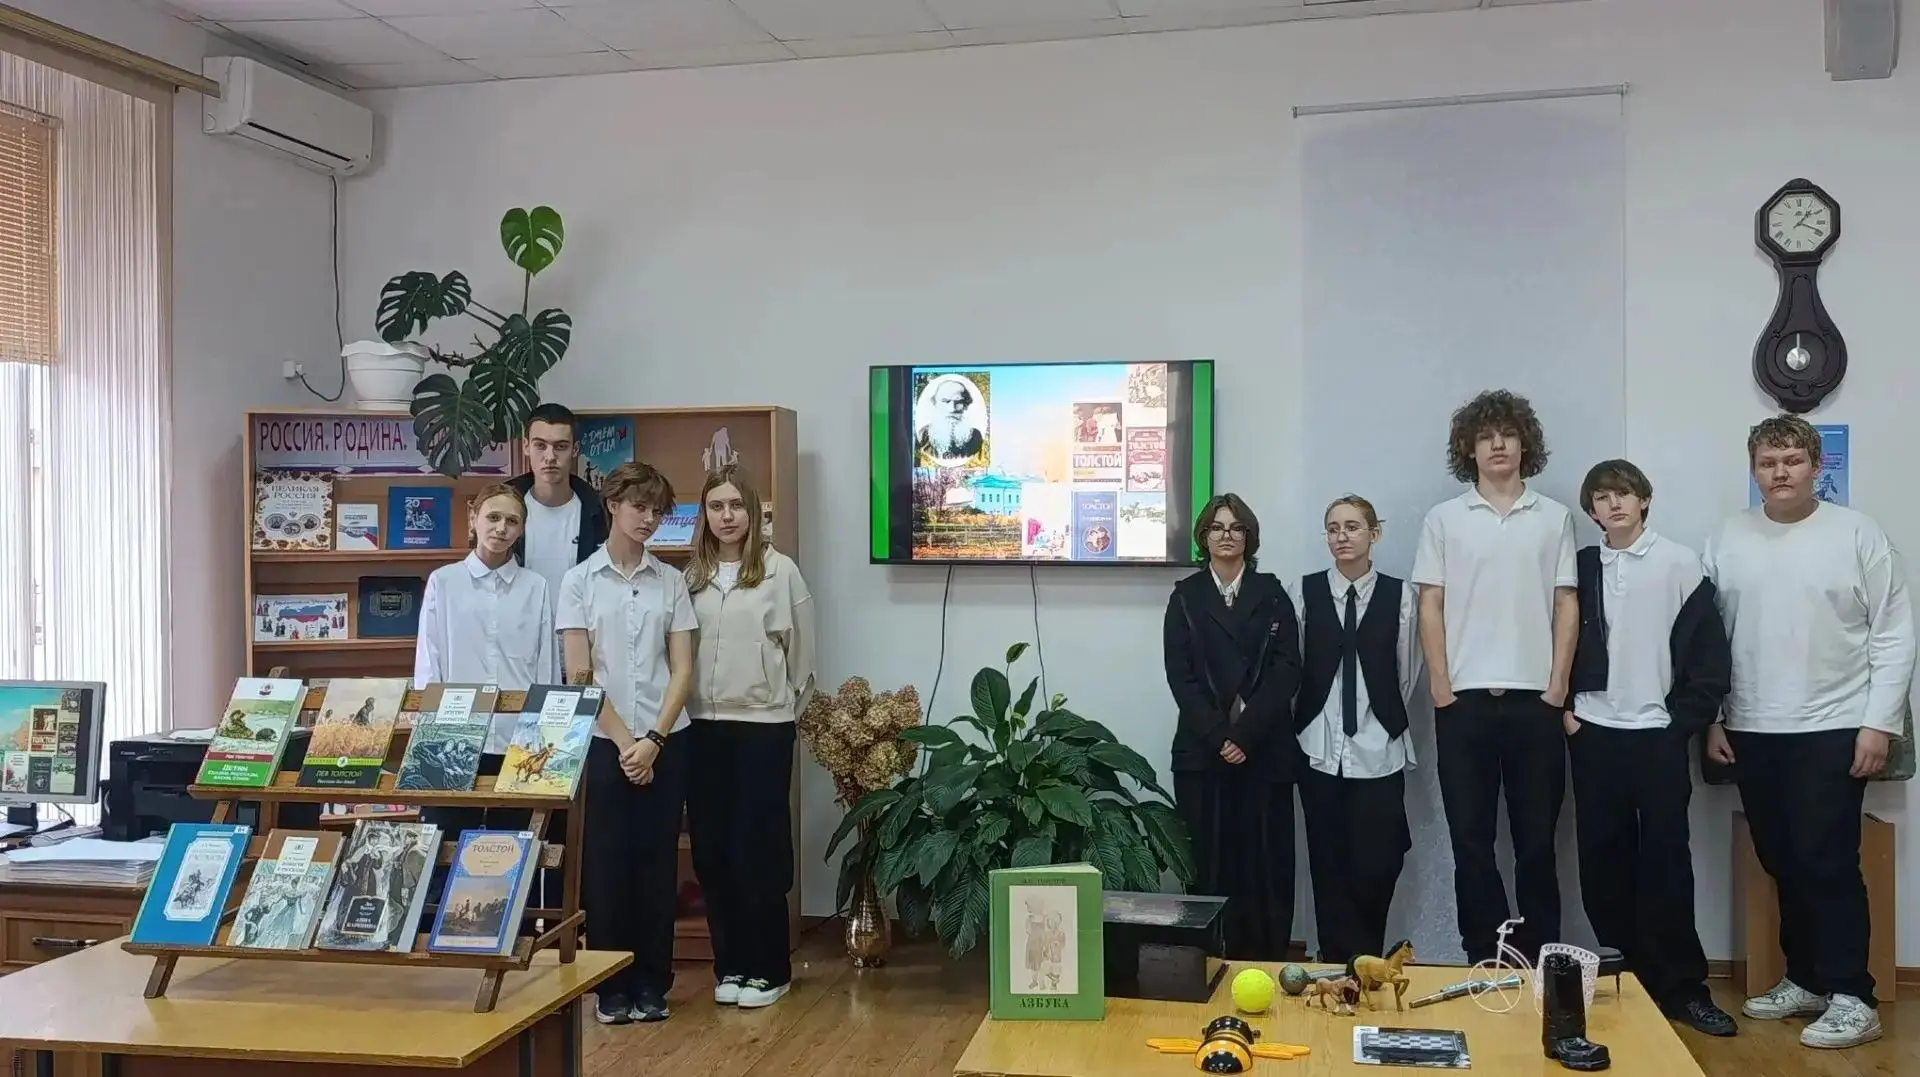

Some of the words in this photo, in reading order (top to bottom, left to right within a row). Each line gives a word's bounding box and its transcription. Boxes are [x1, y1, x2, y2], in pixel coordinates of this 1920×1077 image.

[260, 422, 329, 452] РОССИЯ.
[333, 422, 407, 460] РОДИНА.
[1073, 453, 1122, 468] ТОЛСТОЙ
[274, 492, 317, 500] РОССИЯ
[405, 500, 420, 508] 20
[585, 689, 600, 697] 12+
[330, 770, 363, 778] ТОЛСТОЙ
[1019, 998, 1070, 1008] АЗБУКА
